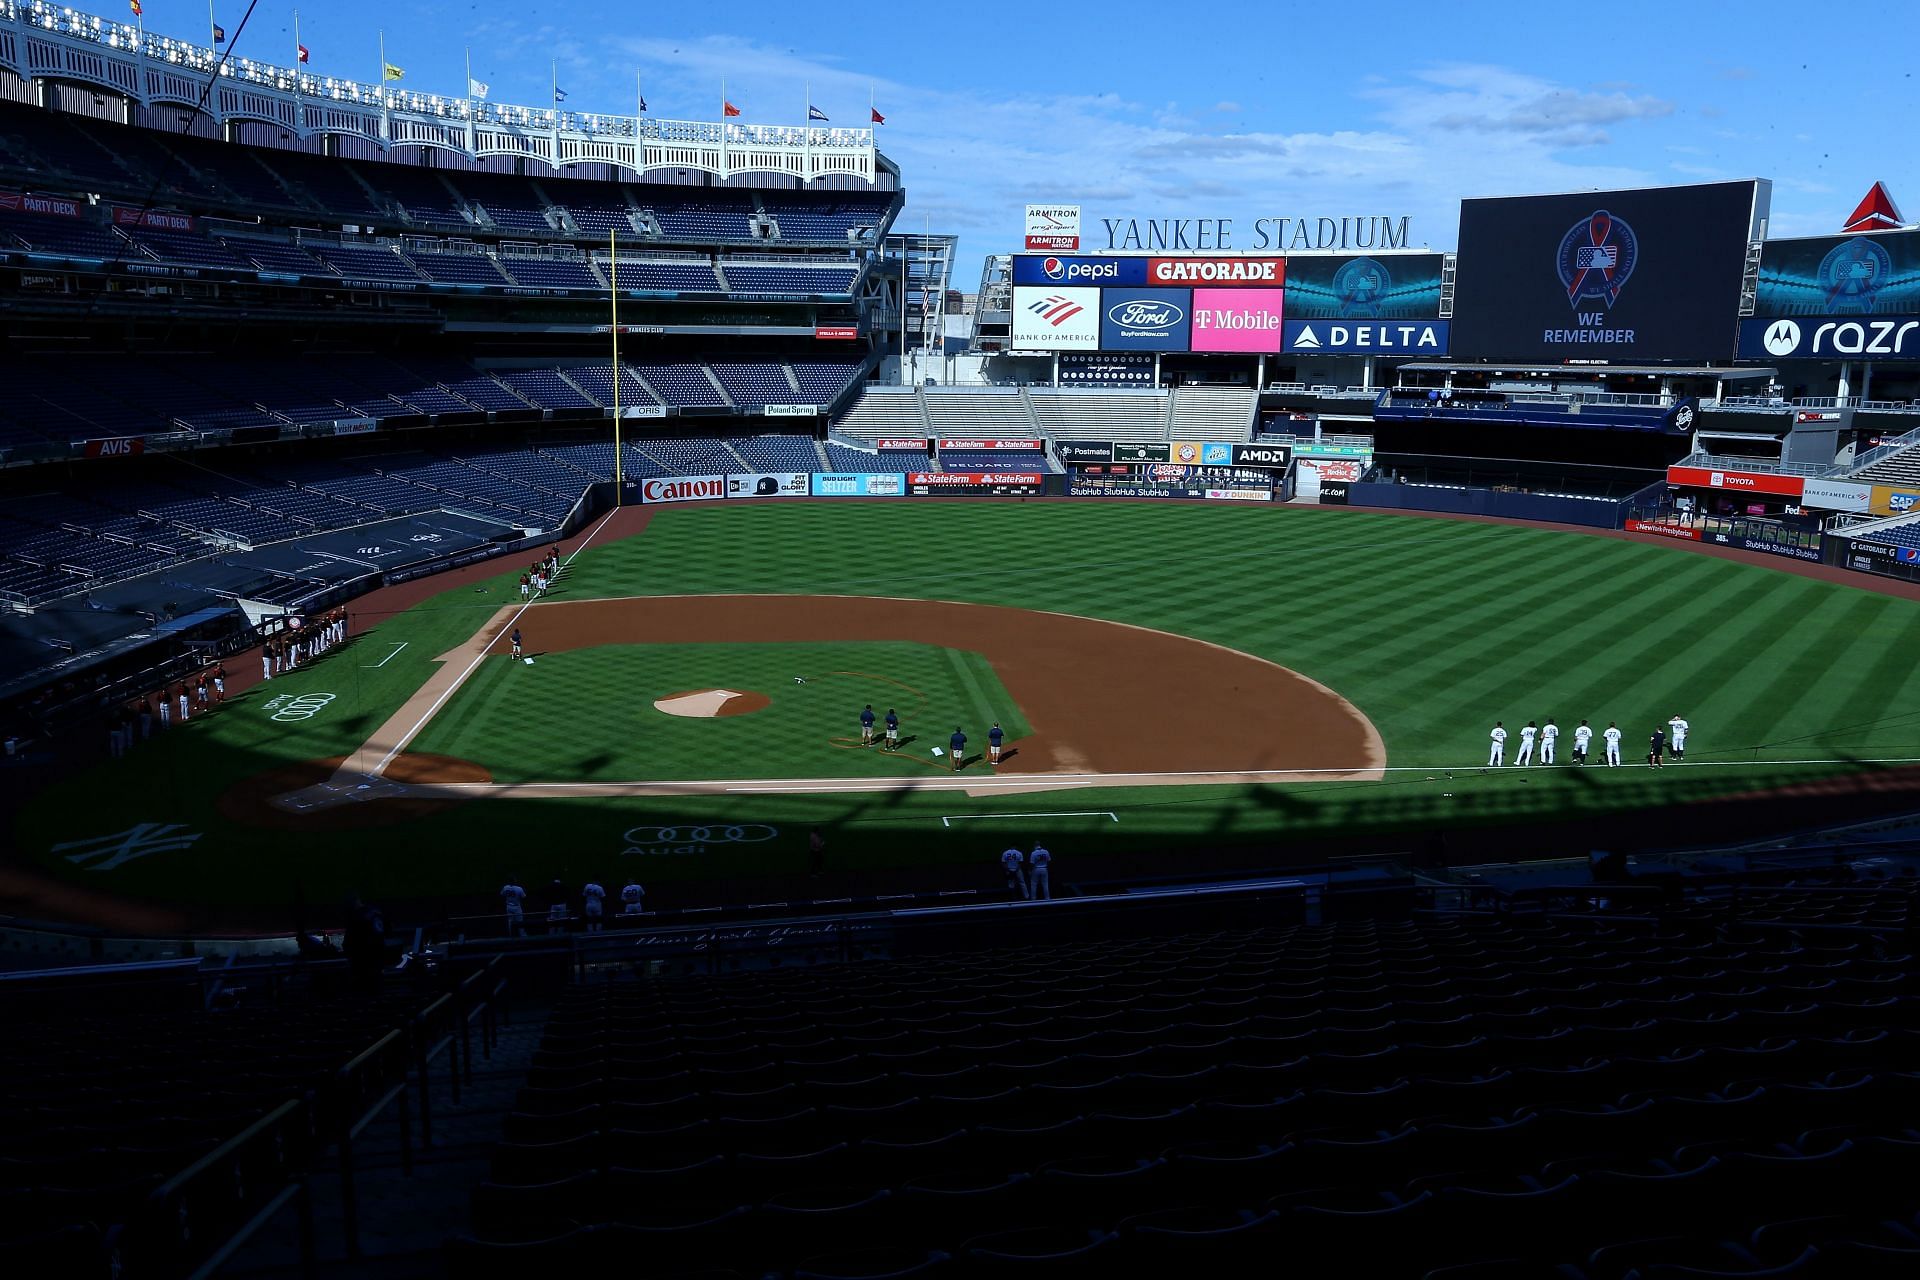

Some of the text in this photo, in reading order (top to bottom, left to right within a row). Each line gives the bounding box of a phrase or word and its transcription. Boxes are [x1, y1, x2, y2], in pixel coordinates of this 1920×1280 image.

[24, 198, 77, 216] PARTY DECK
[1028, 210, 1077, 218] ARMITRON
[147, 215, 190, 229] PARTY DECK
[1101, 216, 1412, 250] YANKEE STADIUM
[1068, 261, 1119, 280] pepsi
[1157, 262, 1277, 280] GATORADE
[1121, 304, 1168, 325] Ford
[1578, 312, 1604, 326] WE
[1054, 334, 1096, 342] AMERICA
[1330, 326, 1438, 347] DELTA
[1544, 329, 1635, 343] REMEMBER
[1813, 321, 1919, 353] razr
[768, 406, 814, 416] Poland Spring
[337, 423, 351, 433] visit
[100, 439, 131, 455] AVIS
[1074, 448, 1111, 456] Postmates
[1240, 450, 1271, 461] AMD
[822, 481, 857, 492] SELTZER
[1725, 477, 1755, 486] TOYOTA
[643, 479, 723, 500] Canon
[1070, 488, 1170, 497] StubHub StubHub StubHub
[1829, 492, 1855, 500] AMERICA
[1890, 495, 1914, 509] SAP
[1785, 504, 1809, 516] FedEx
[1745, 540, 1819, 560] StubHub StubHub StubHub
[1858, 544, 1888, 555] GATORADE
[620, 845, 706, 856] Audi
